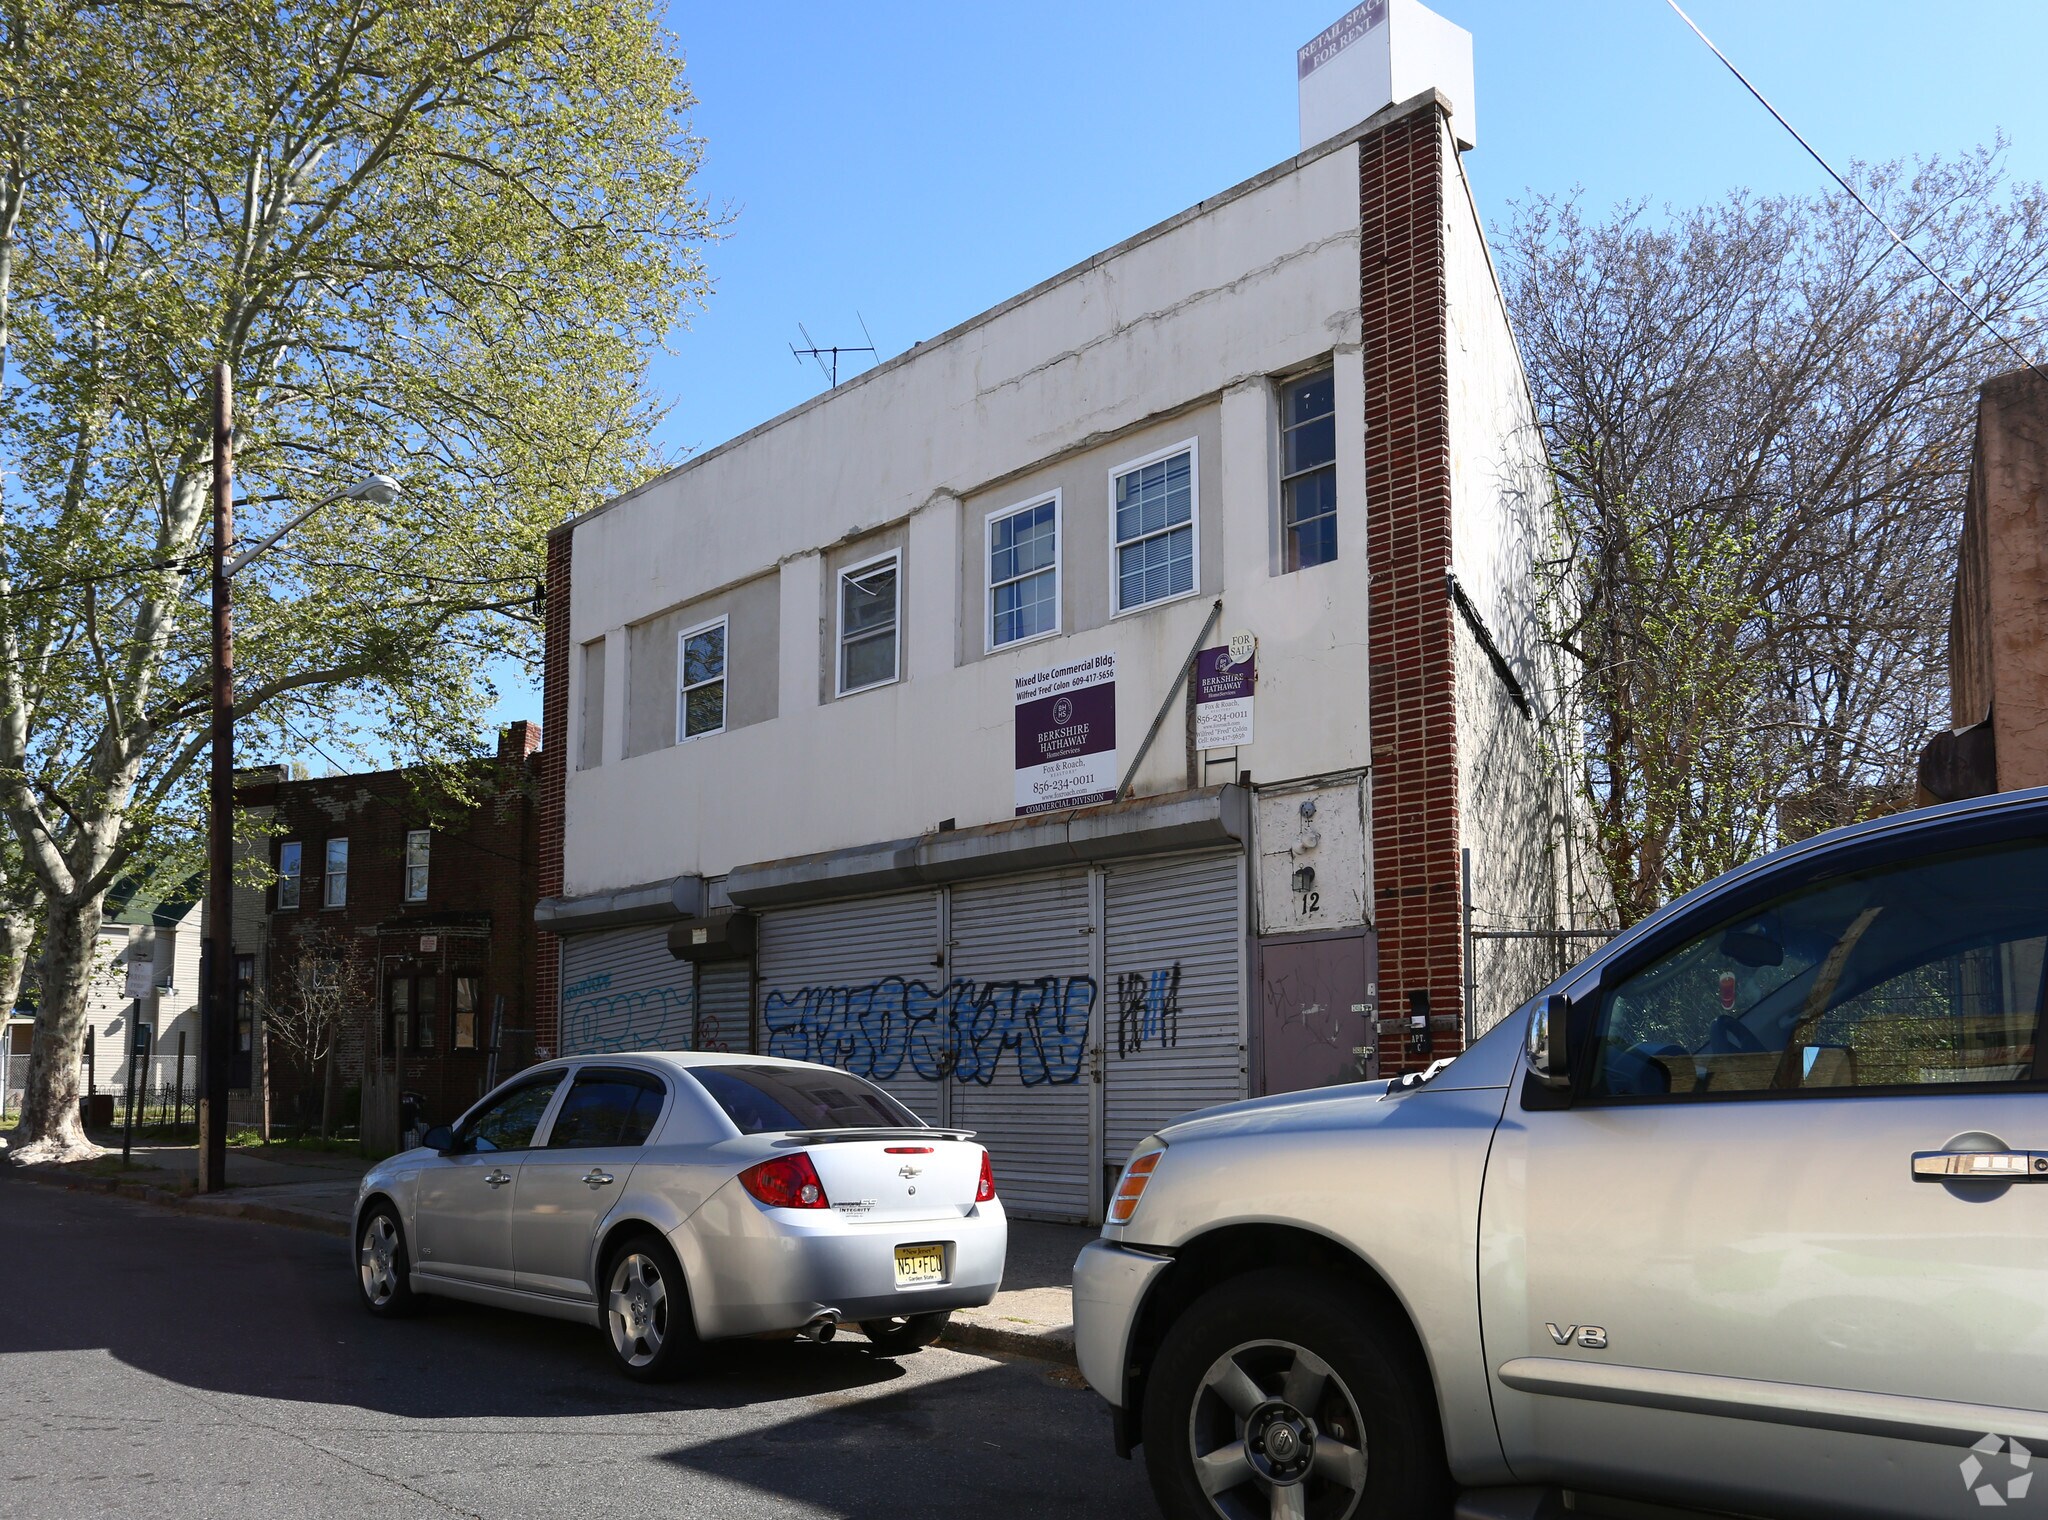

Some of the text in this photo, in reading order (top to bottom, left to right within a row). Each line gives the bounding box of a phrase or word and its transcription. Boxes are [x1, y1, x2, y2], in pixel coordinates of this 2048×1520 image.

[1301, 22, 1344, 60] RETAIL
[1313, 16, 1372, 68] FOR RENT
[1232, 635, 1250, 646] FOR
[1015, 654, 1115, 689] Mixed Use Commercial Bldg.
[1202, 673, 1244, 687] BERKSHIRE
[1016, 689, 1037, 701] Wilfred
[1053, 680, 1070, 691] Colon
[1072, 669, 1114, 687] 609-417-5656
[1203, 681, 1242, 693] HATHAWAY
[1197, 711, 1248, 725] 856-234-0011
[1038, 723, 1090, 743] BERKSHIRE
[1040, 734, 1087, 753] HATHAWAY
[1046, 747, 1080, 759] HomeServices
[1043, 758, 1086, 774] Fox & Roach,
[1033, 774, 1094, 795] 856-234-0011
[1041, 788, 1088, 800] www.foxroach.com
[1025, 793, 1104, 814] COMMERCIAL DIVISION
[1302, 892, 1320, 915] 12
[1411, 1034, 1426, 1043] APT.
[1417, 1043, 1421, 1052] C
[1545, 1322, 1608, 1349] V8
